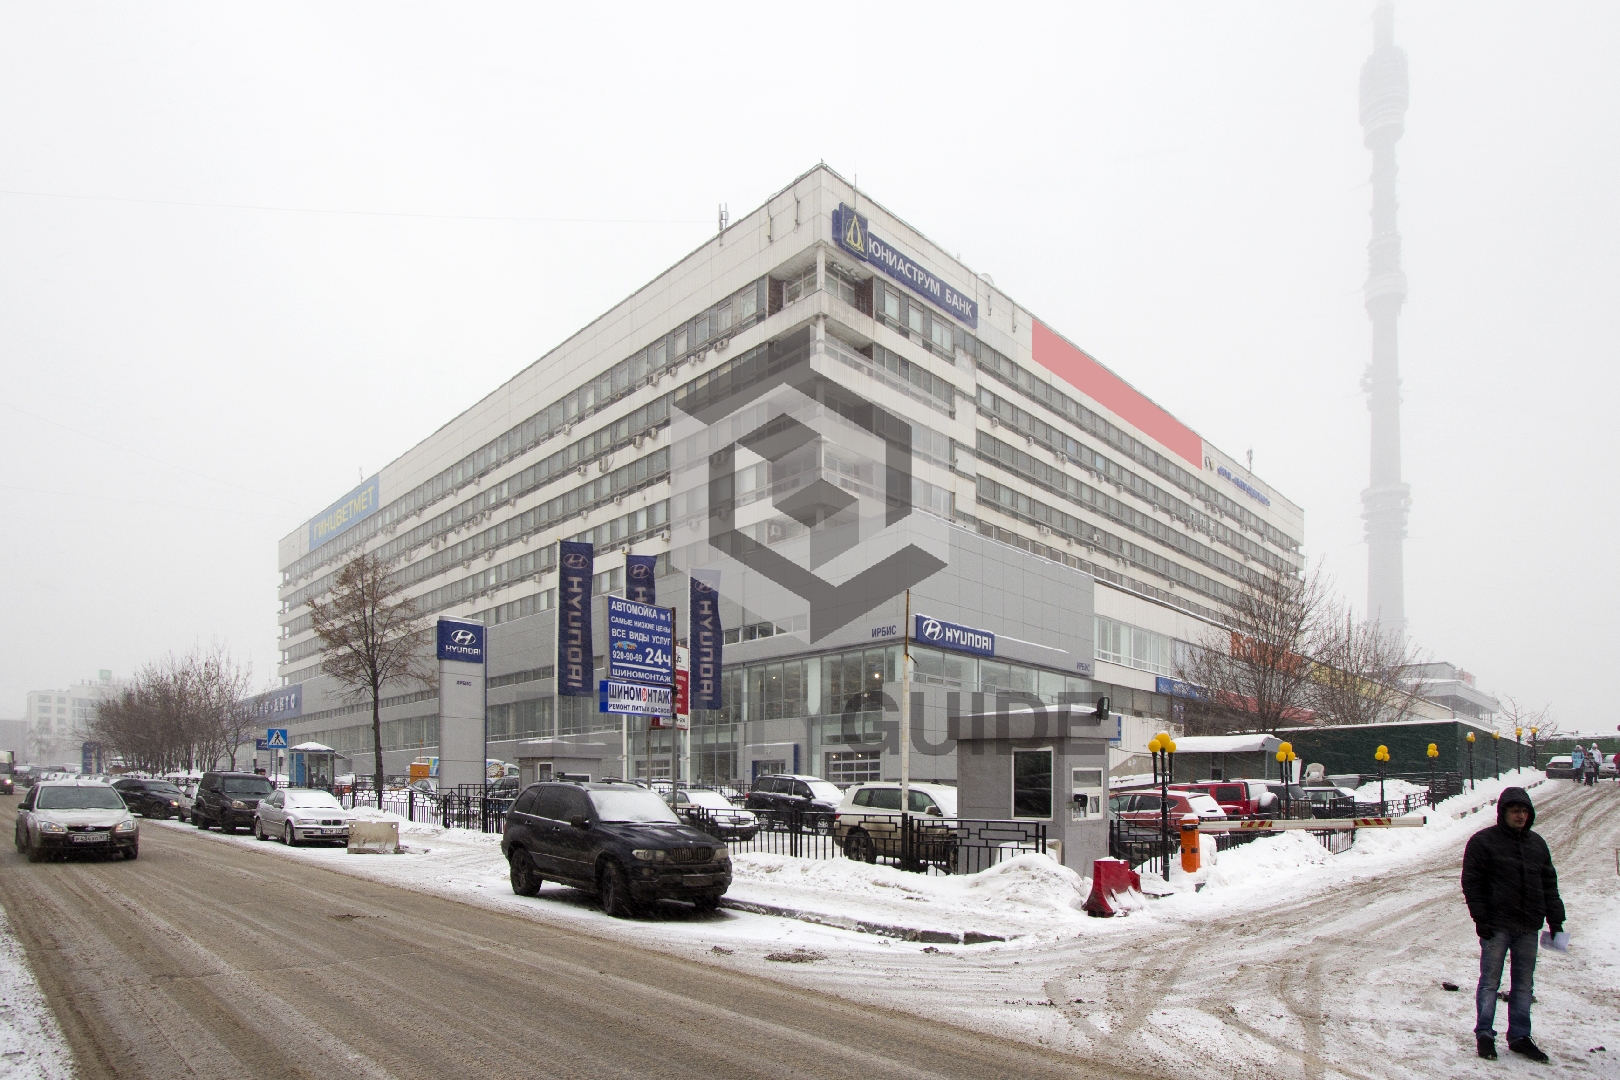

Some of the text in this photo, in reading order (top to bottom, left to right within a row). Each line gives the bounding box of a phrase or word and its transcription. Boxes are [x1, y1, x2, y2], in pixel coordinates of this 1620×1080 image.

[868, 237, 973, 319] ЮНИАСТРУМ БАНК
[611, 600, 658, 619] АВТОМОЙКА
[666, 612, 671, 622] 1
[567, 576, 583, 688] HYUNDAI
[610, 615, 671, 634] САМЫЕ НИЗКИЕ ЦЕНЫ
[871, 624, 897, 638] ИРБИС
[611, 627, 627, 639] ВСЕ
[628, 630, 650, 643] ВИДЫ
[651, 635, 671, 646] УСЛУГ
[945, 627, 992, 651] HYUNDAI
[445, 644, 481, 656] HYUNDAI
[645, 647, 671, 667] 24ч
[699, 600, 714, 701] HYUNDAI
[612, 668, 671, 683] ШИНОМОНТАЖ
[608, 683, 670, 705] ШИНОМОНТАЖ
[608, 703, 631, 711] РЕМОНТ
